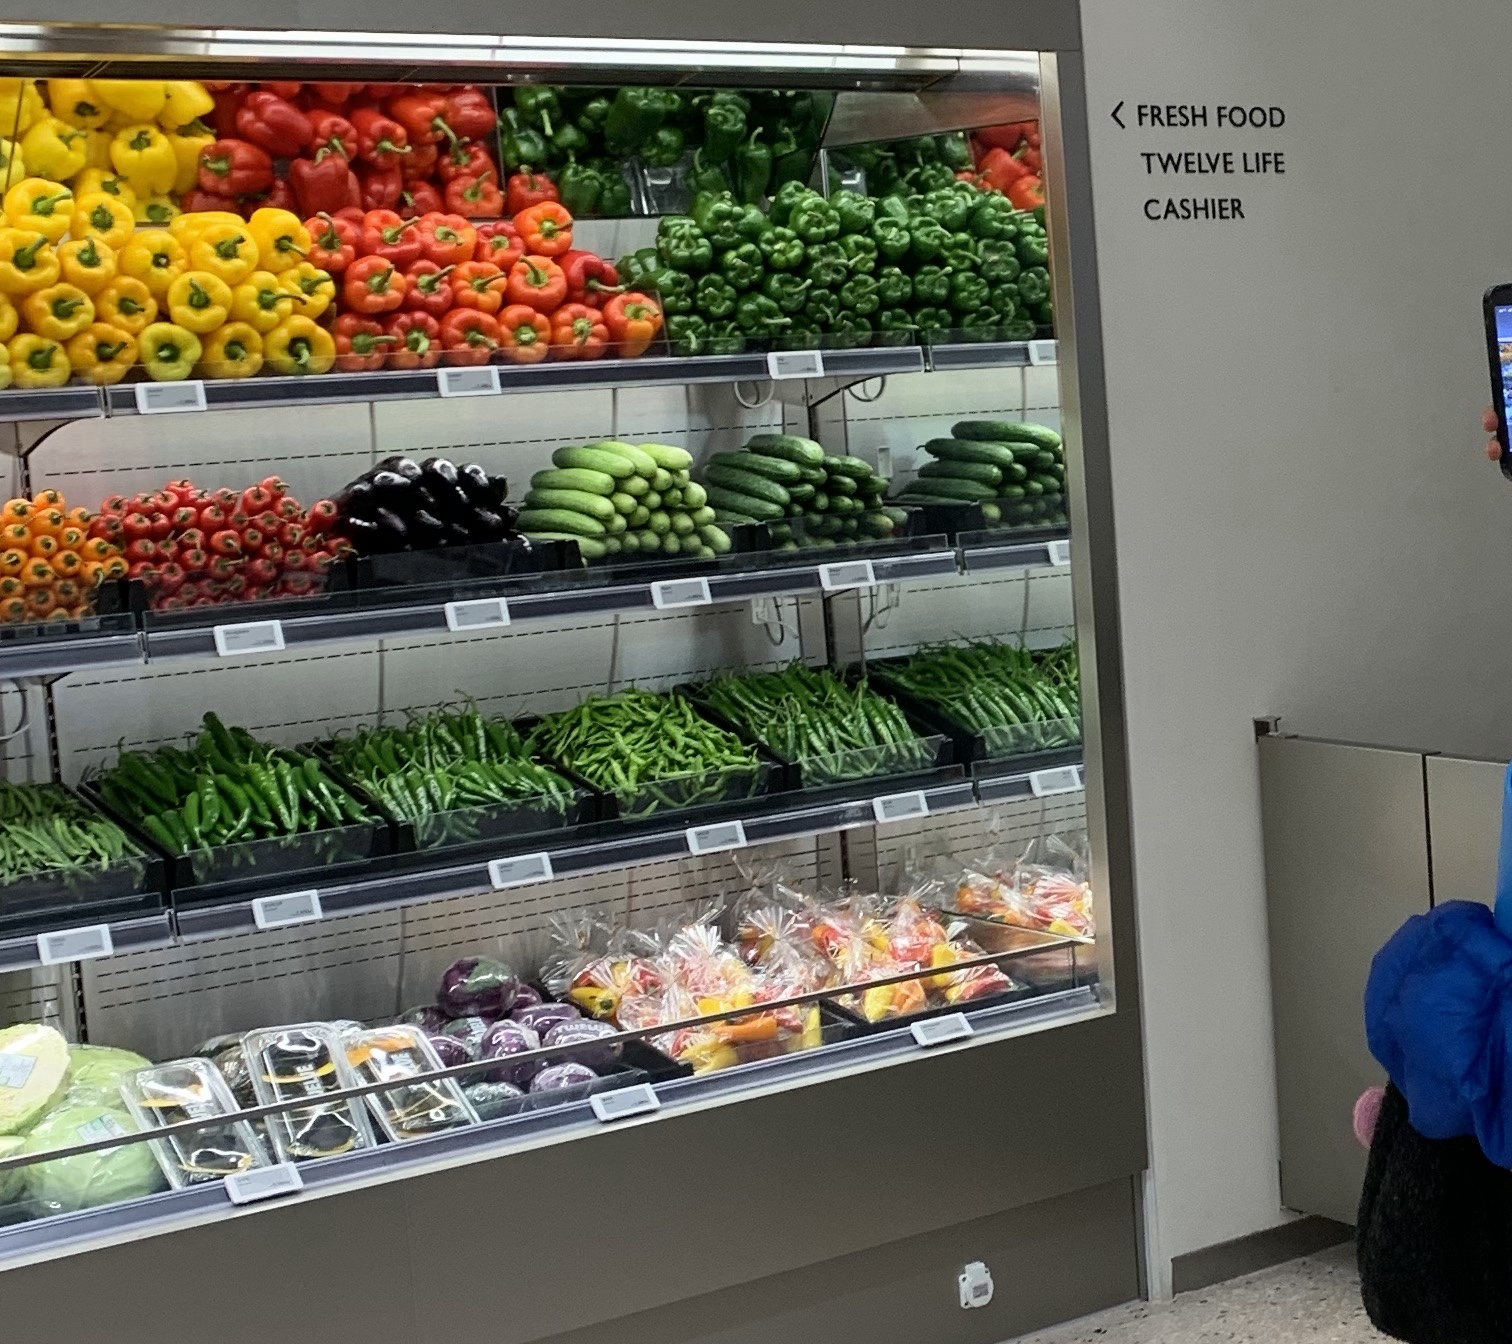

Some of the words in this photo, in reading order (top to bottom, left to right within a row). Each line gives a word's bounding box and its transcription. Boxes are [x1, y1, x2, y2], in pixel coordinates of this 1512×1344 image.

[1137, 104, 1208, 127] FRESH
[1217, 106, 1286, 128] FOOD
[1140, 152, 1235, 174] TWELVE
[1243, 152, 1286, 174] LIFE
[1144, 198, 1245, 220] CASHIER
